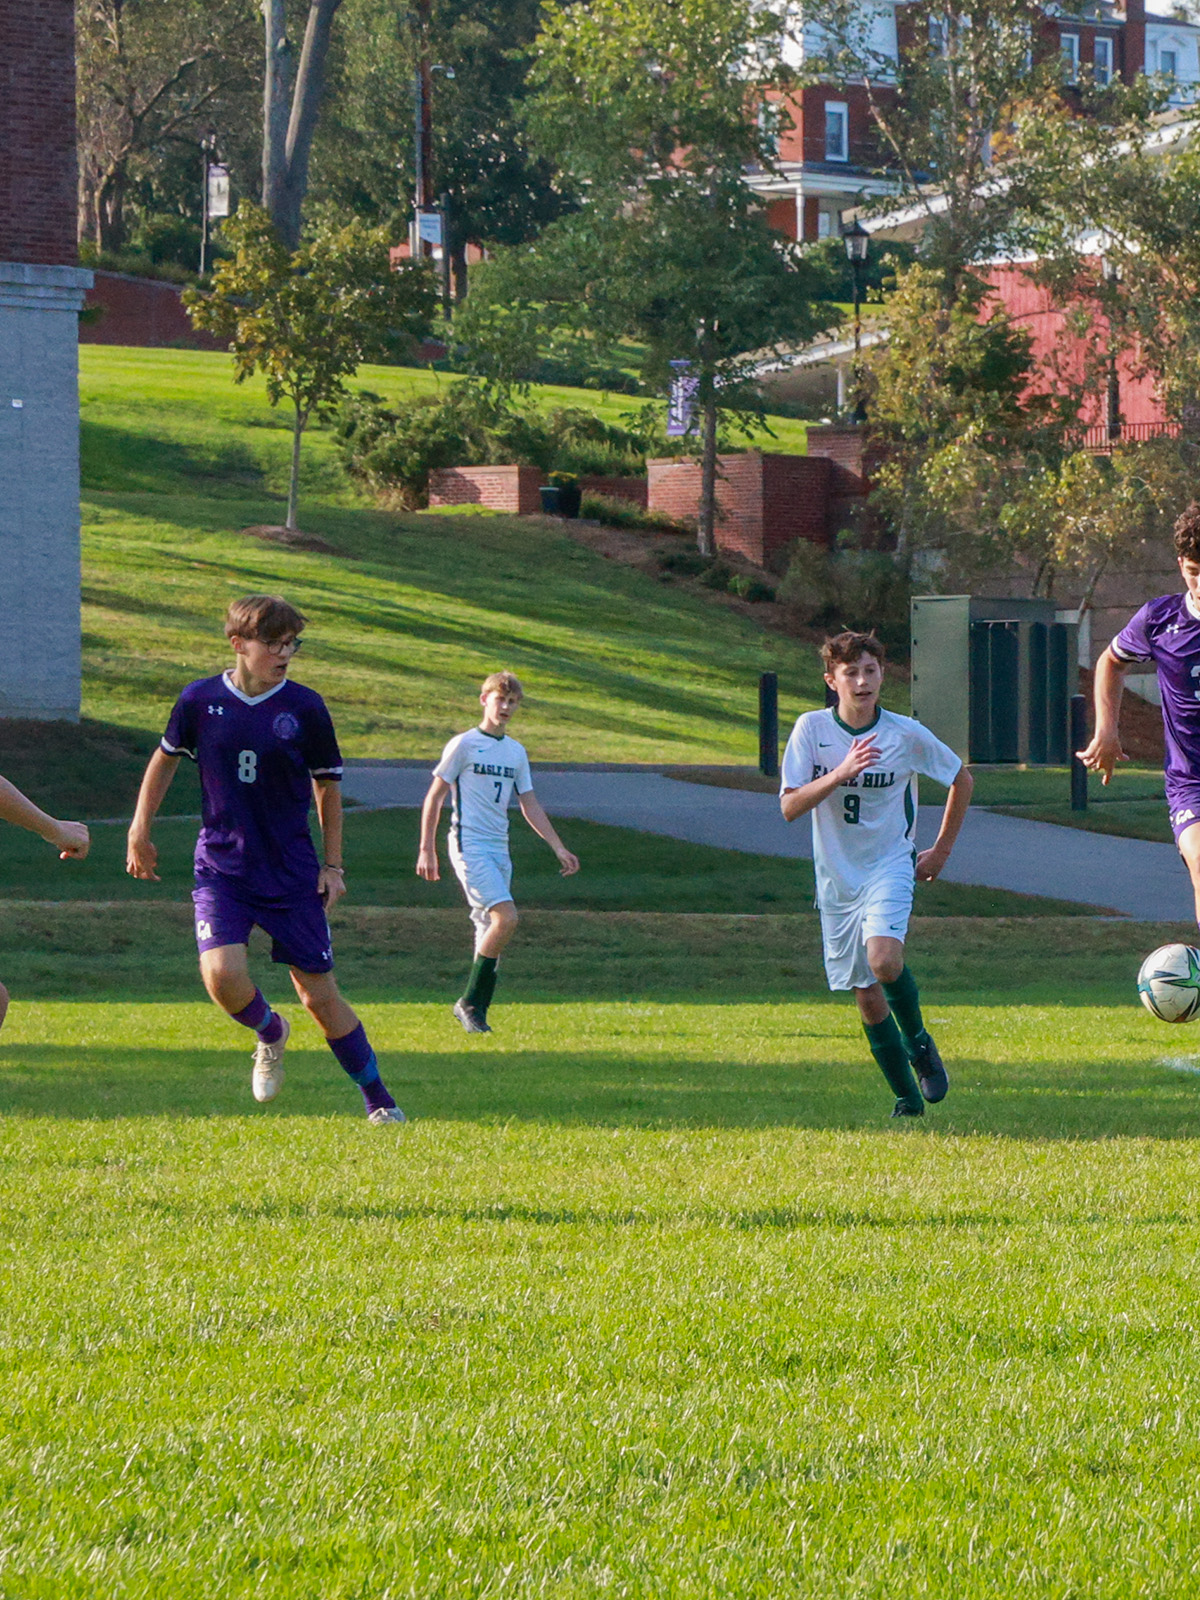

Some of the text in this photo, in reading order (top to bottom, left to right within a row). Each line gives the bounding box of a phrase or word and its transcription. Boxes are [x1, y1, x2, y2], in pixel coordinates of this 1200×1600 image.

[237, 749, 258, 784] 8
[862, 772, 895, 788] HILL
[493, 781, 503, 804] 7
[843, 794, 861, 825] 9
